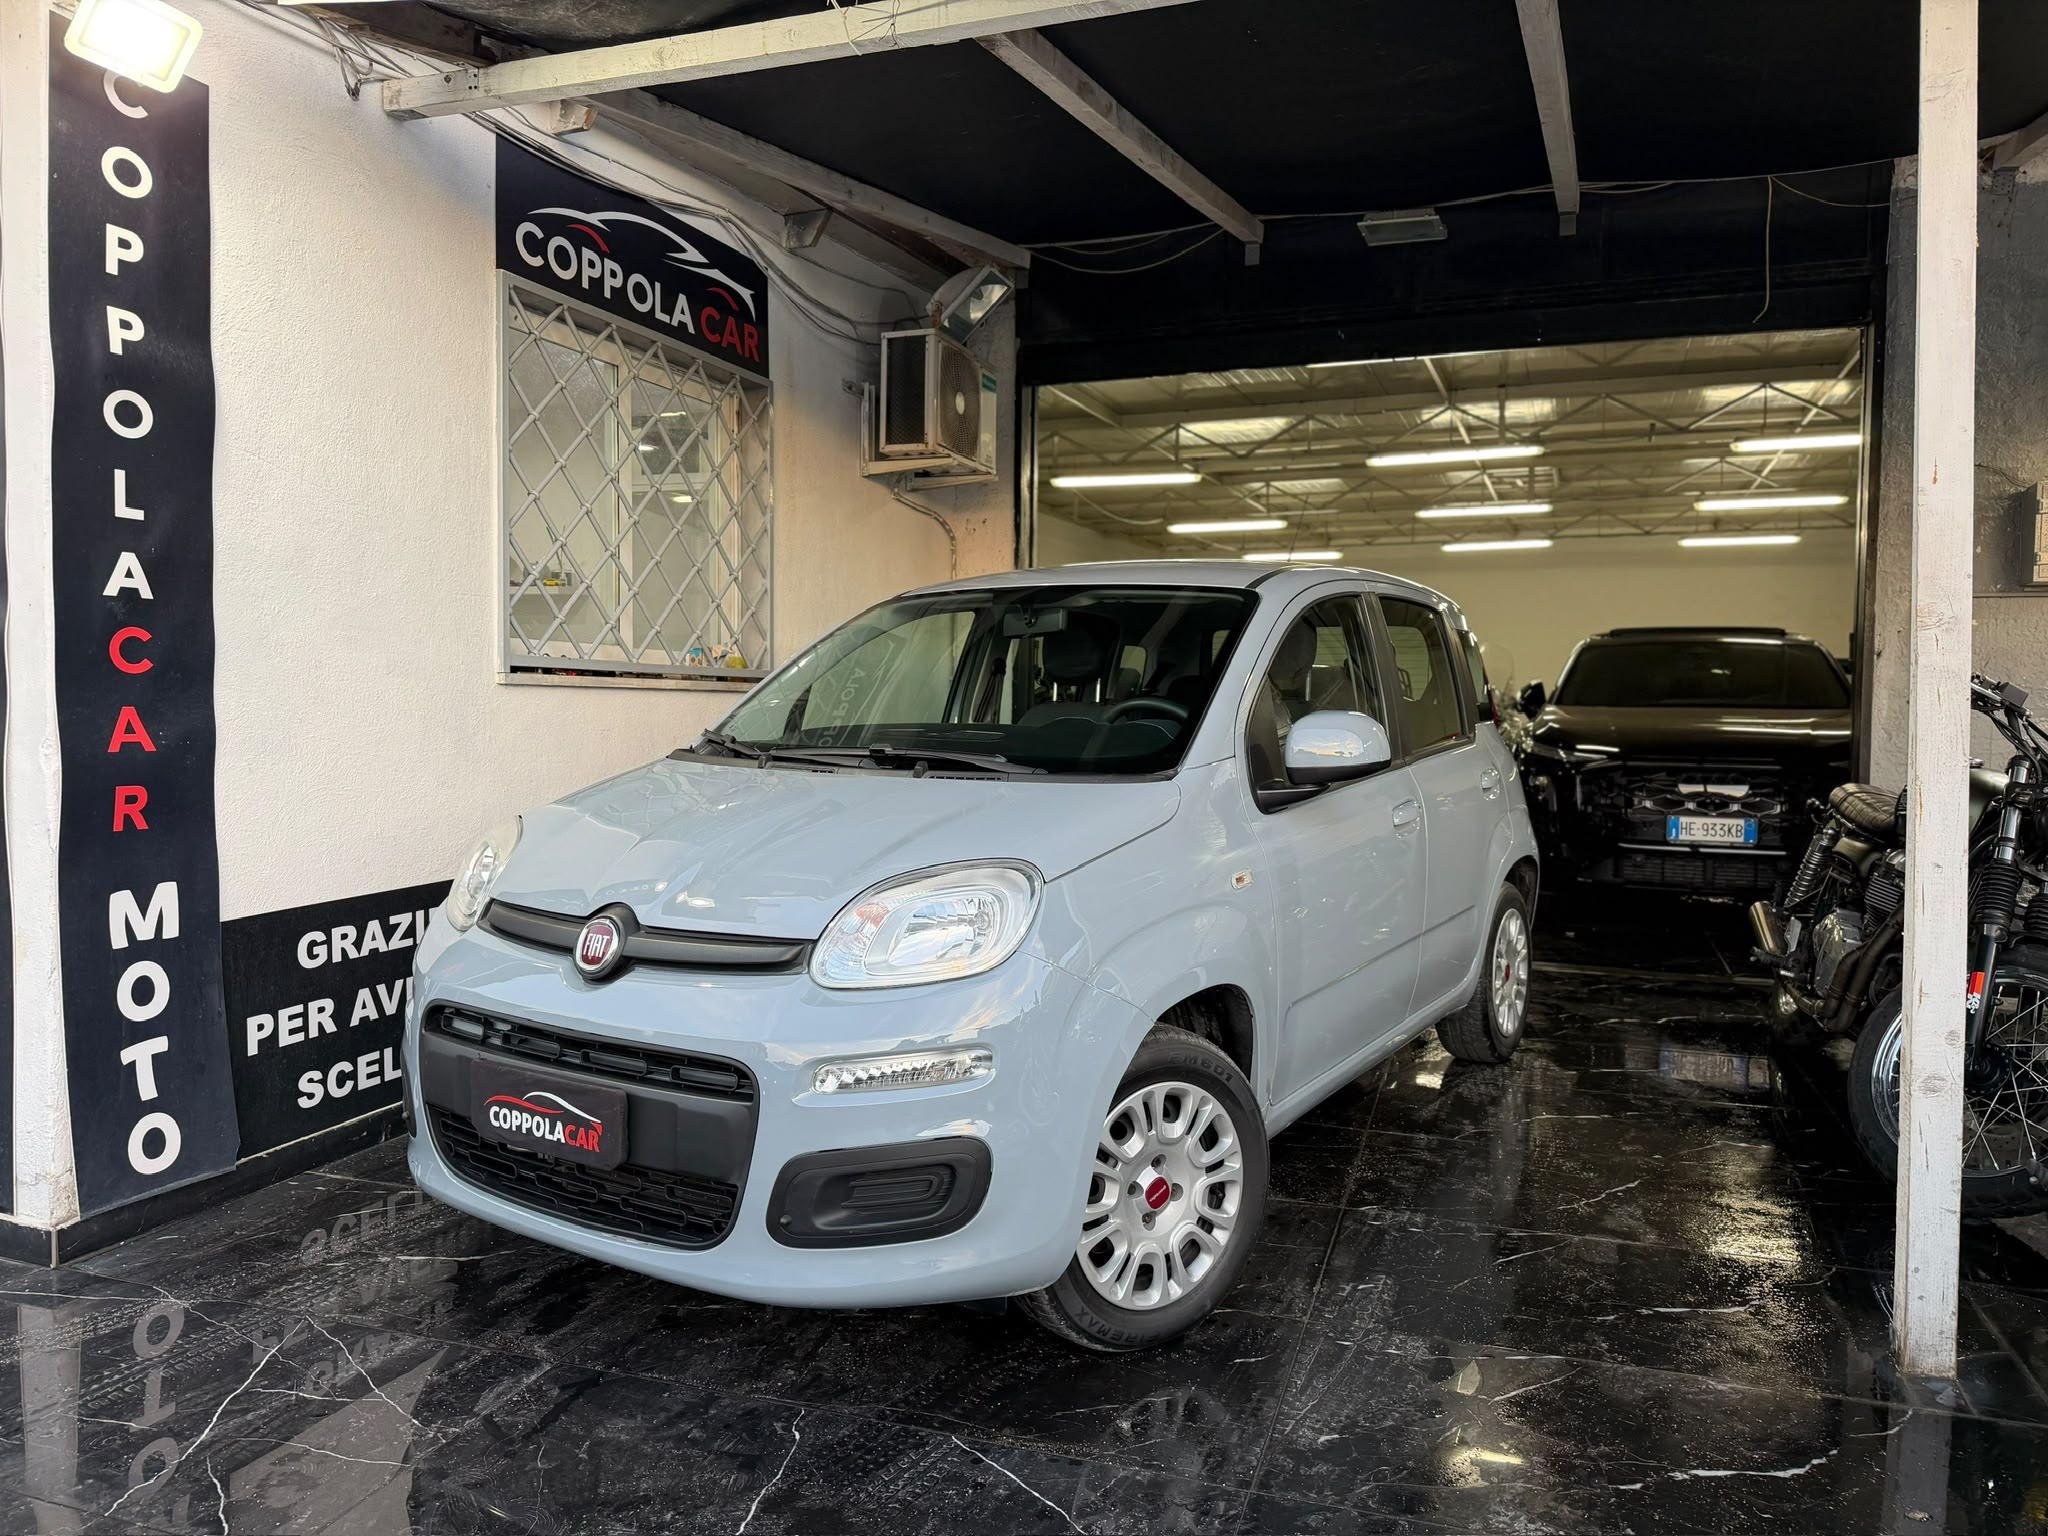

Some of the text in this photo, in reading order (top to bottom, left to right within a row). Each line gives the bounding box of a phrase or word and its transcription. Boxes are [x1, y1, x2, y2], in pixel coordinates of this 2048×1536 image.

[583, 933, 610, 958] FIAT
[109, 881, 181, 1175] MOTO
[246, 997, 337, 1057] PER
